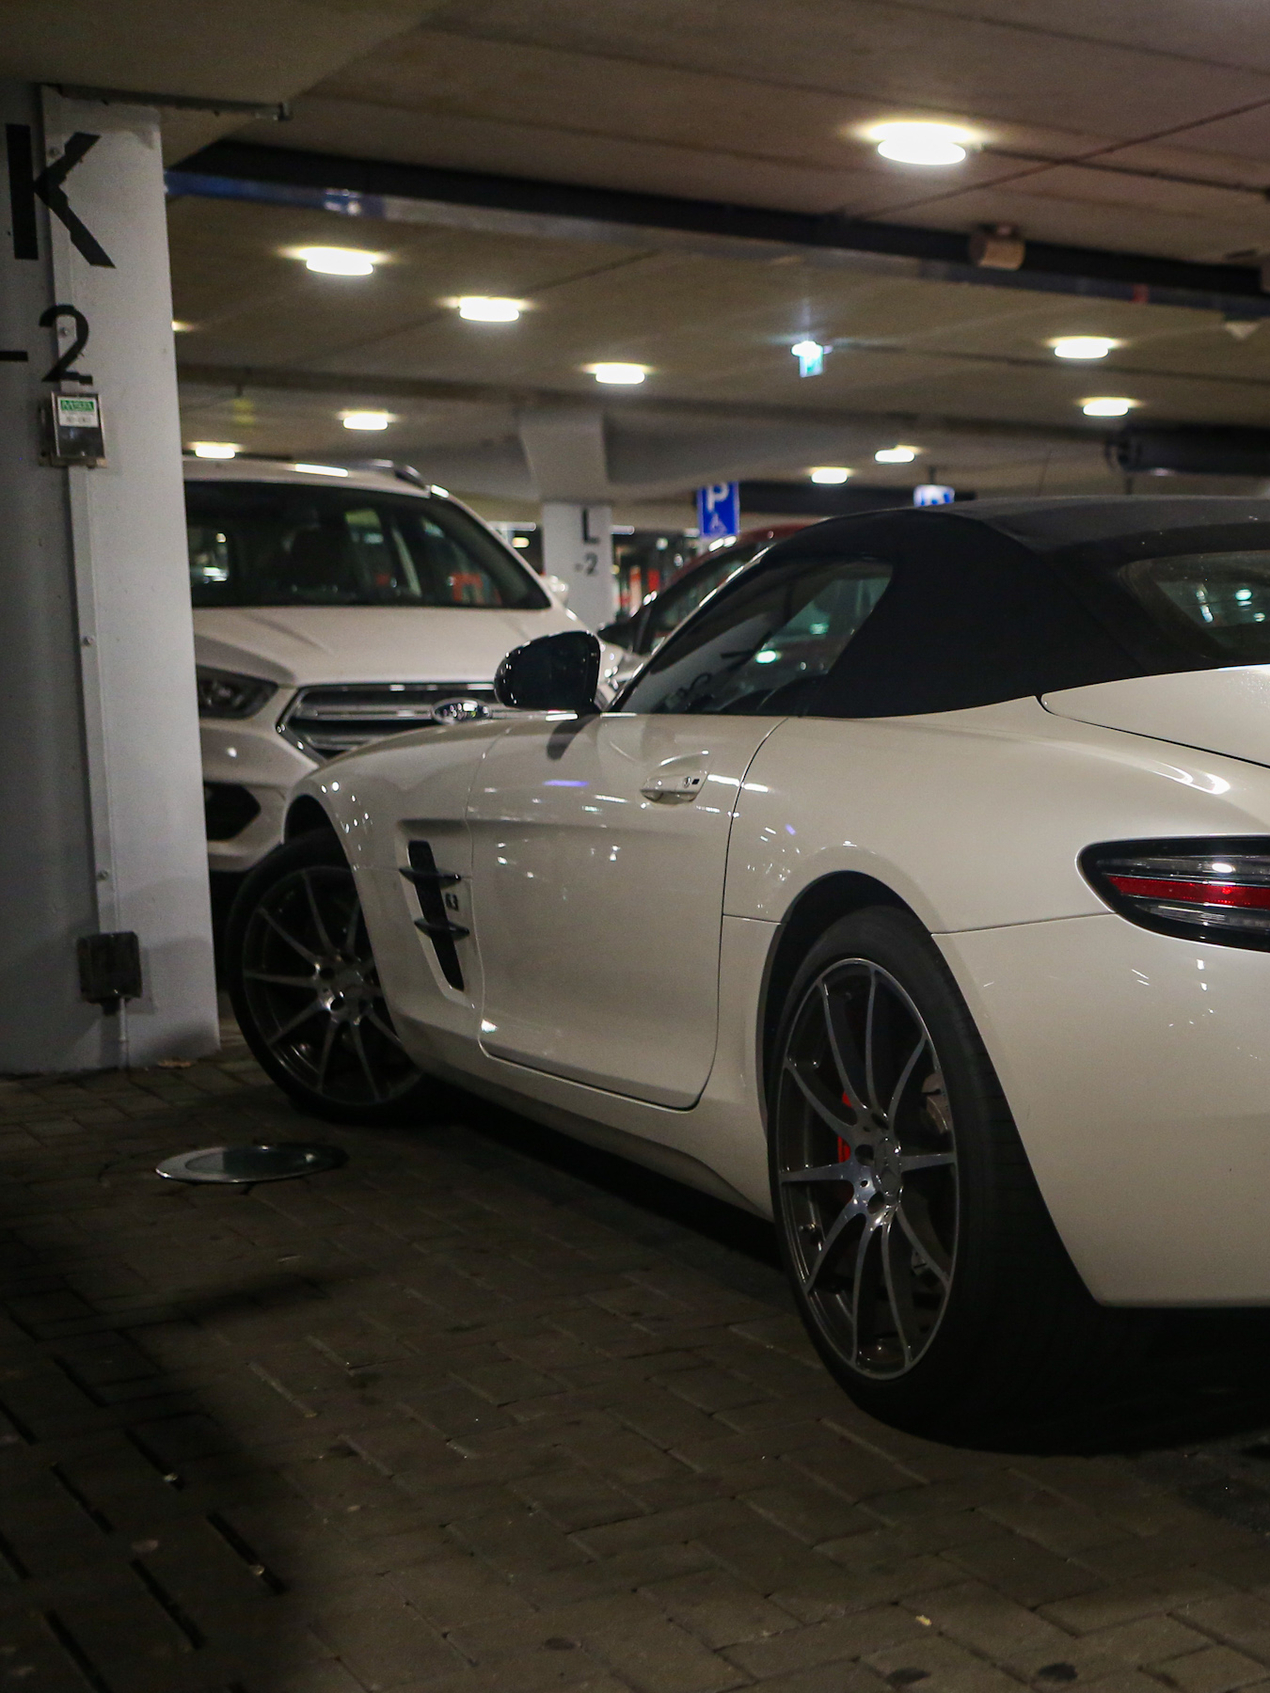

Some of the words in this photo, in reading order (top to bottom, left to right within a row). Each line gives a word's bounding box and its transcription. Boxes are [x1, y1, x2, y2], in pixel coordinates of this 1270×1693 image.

[6, 124, 116, 268] K
[707, 482, 729, 512] P
[582, 509, 599, 543] L
